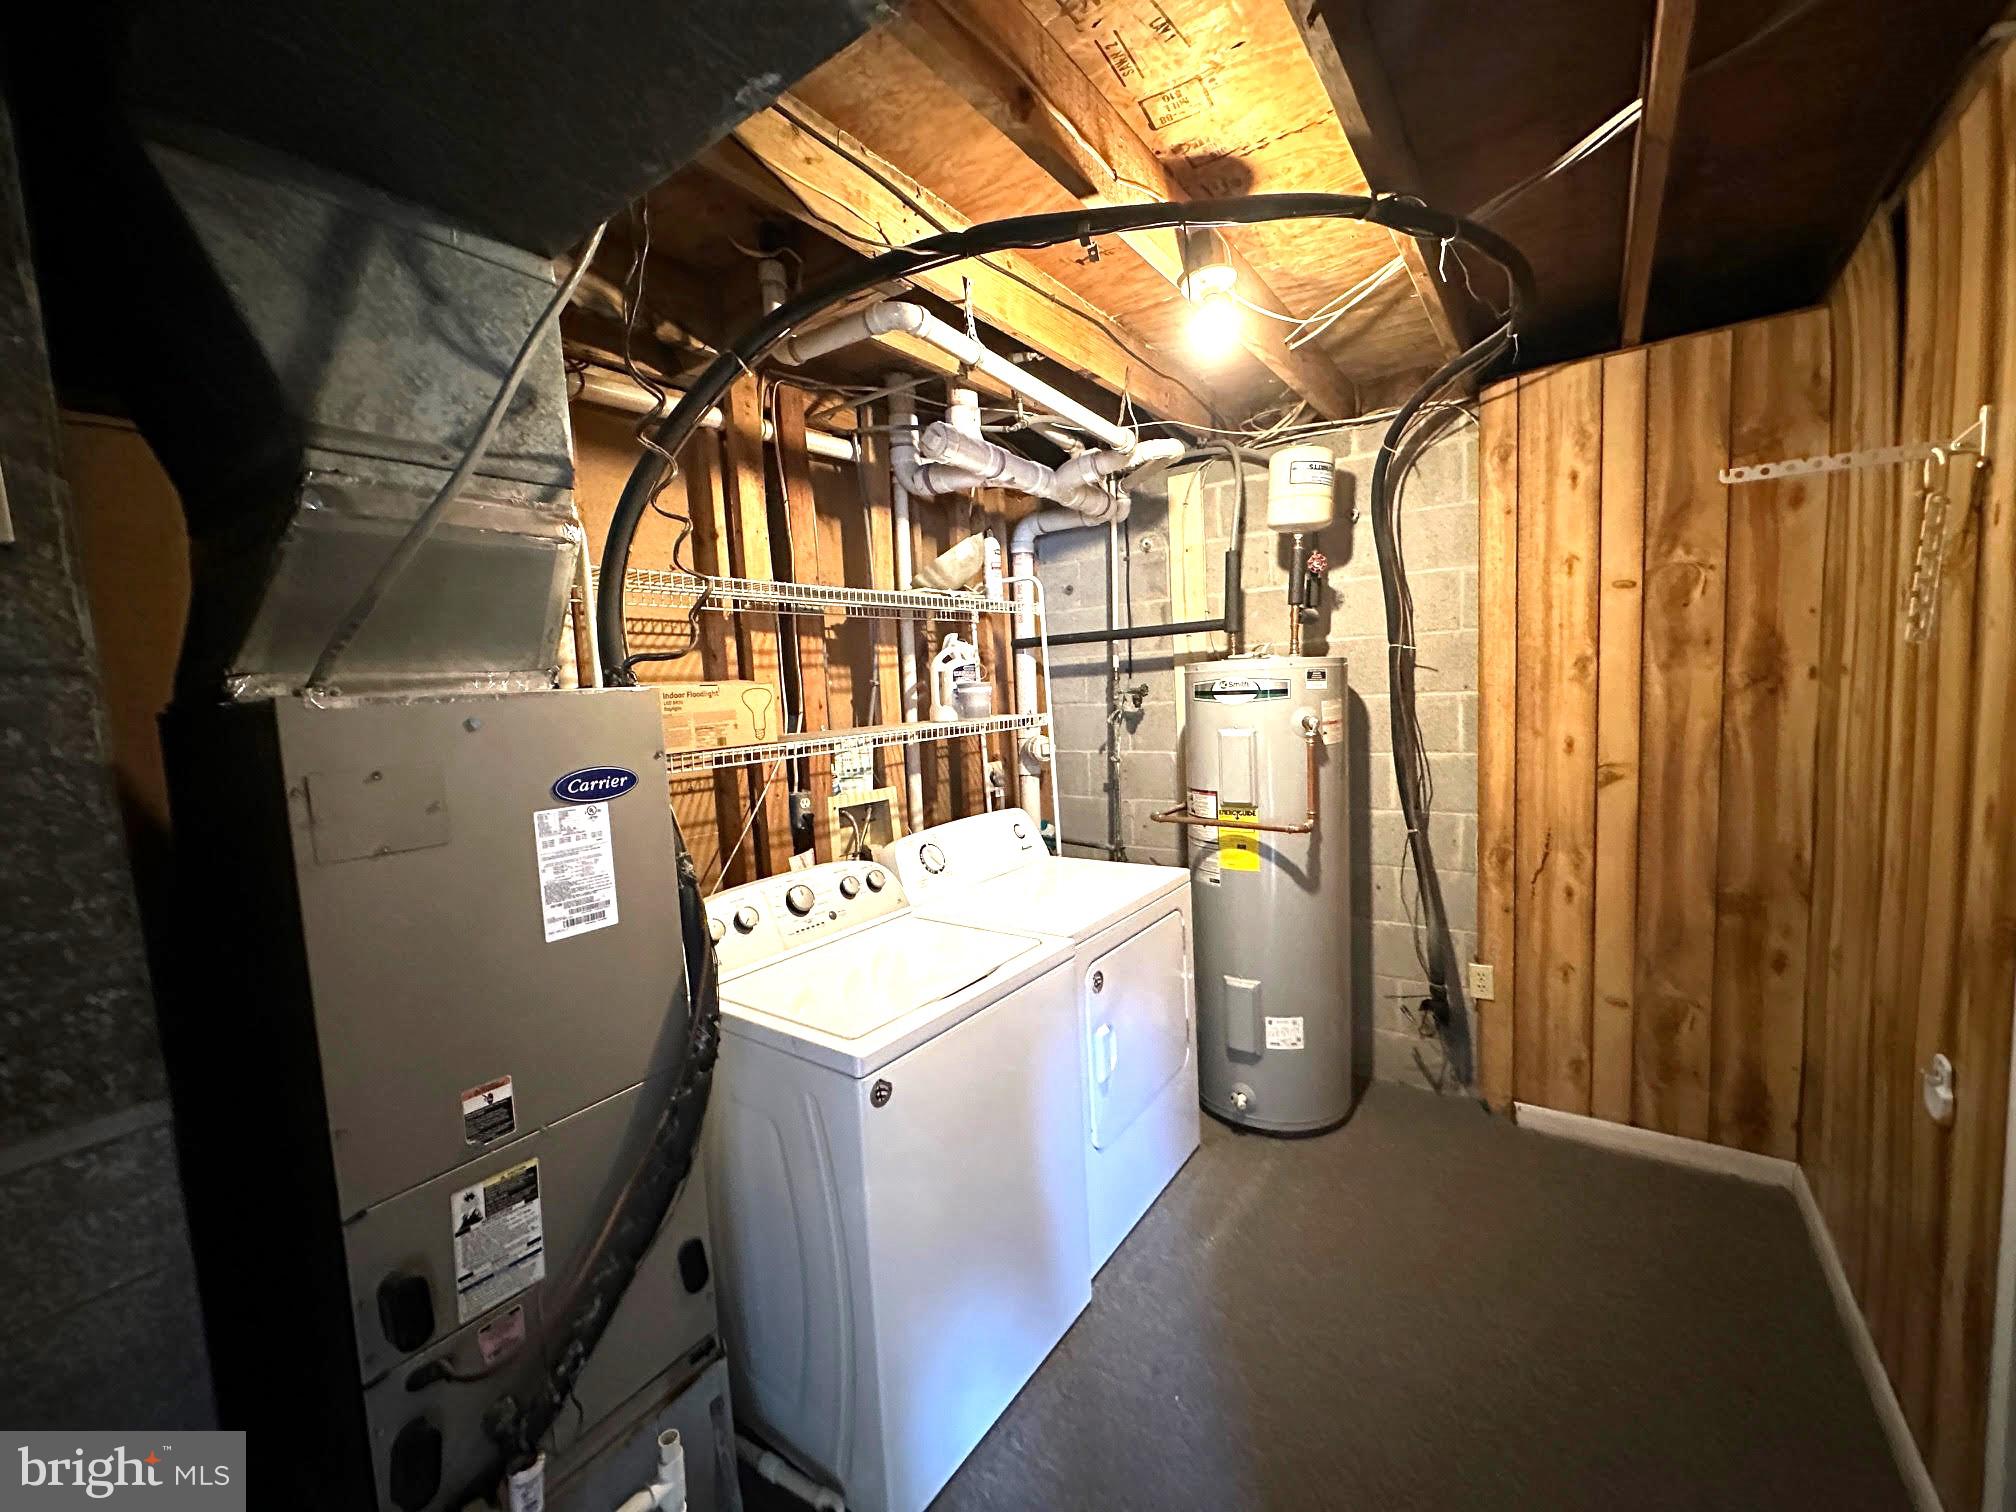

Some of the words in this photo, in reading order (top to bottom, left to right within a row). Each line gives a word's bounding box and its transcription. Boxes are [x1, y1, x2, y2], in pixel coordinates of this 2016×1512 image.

[1111, 47, 1135, 77] SAWN
[686, 691, 720, 699] Floodlight
[567, 776, 628, 794] Carrier
